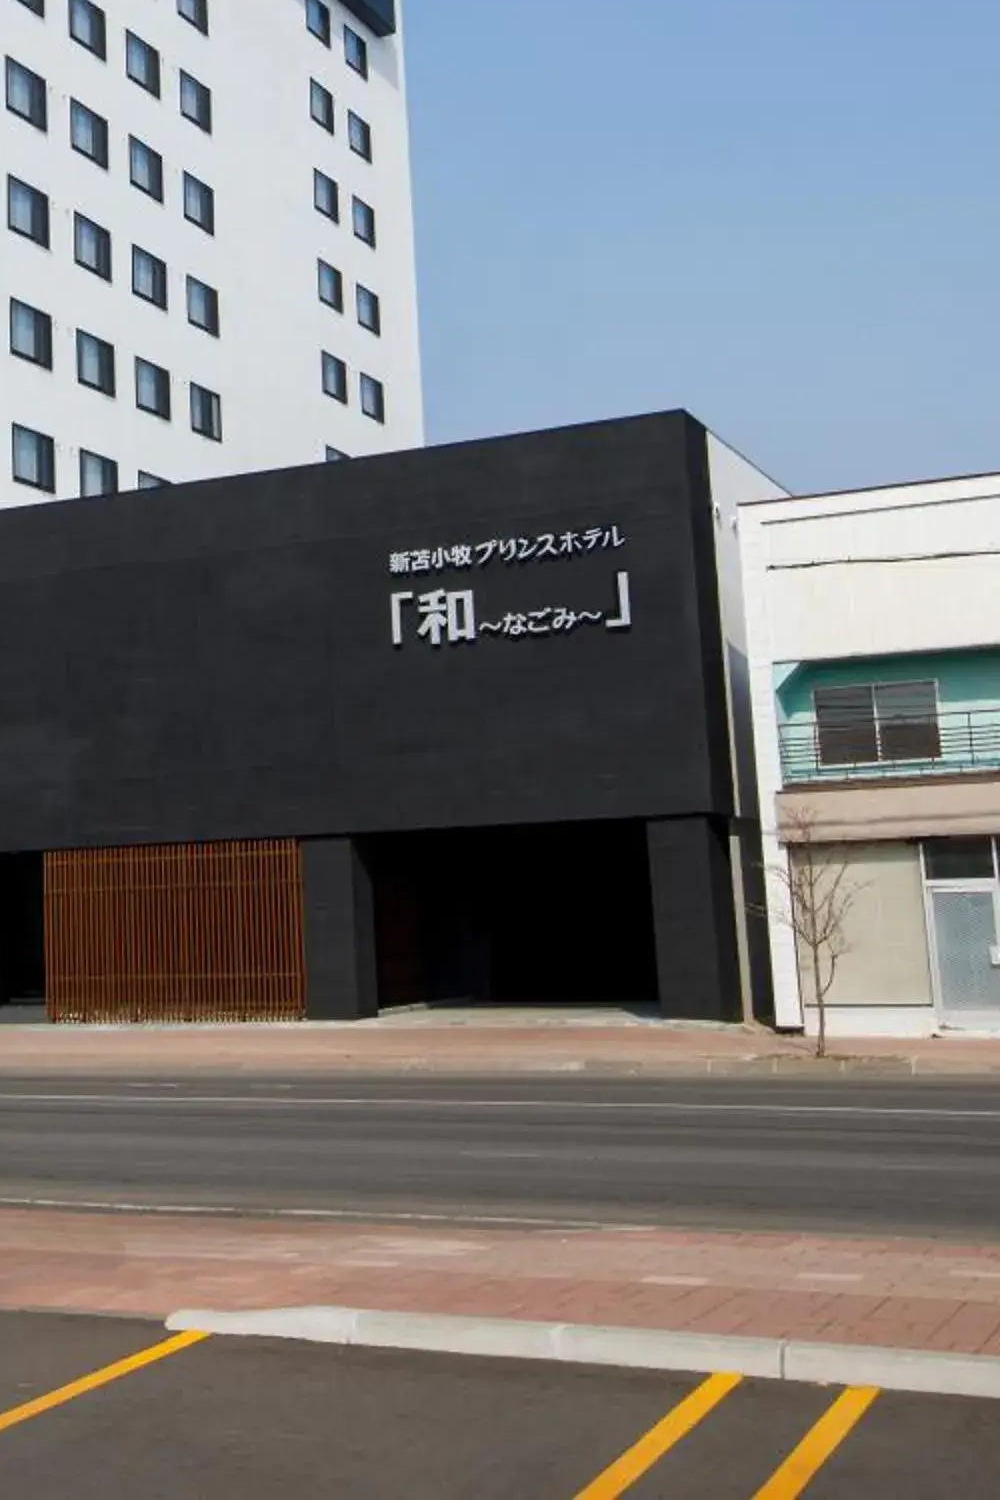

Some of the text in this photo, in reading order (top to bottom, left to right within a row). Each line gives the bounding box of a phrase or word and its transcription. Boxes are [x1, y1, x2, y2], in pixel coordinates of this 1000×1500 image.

[389, 525, 625, 573] 新苫小牧プリンスホテル
